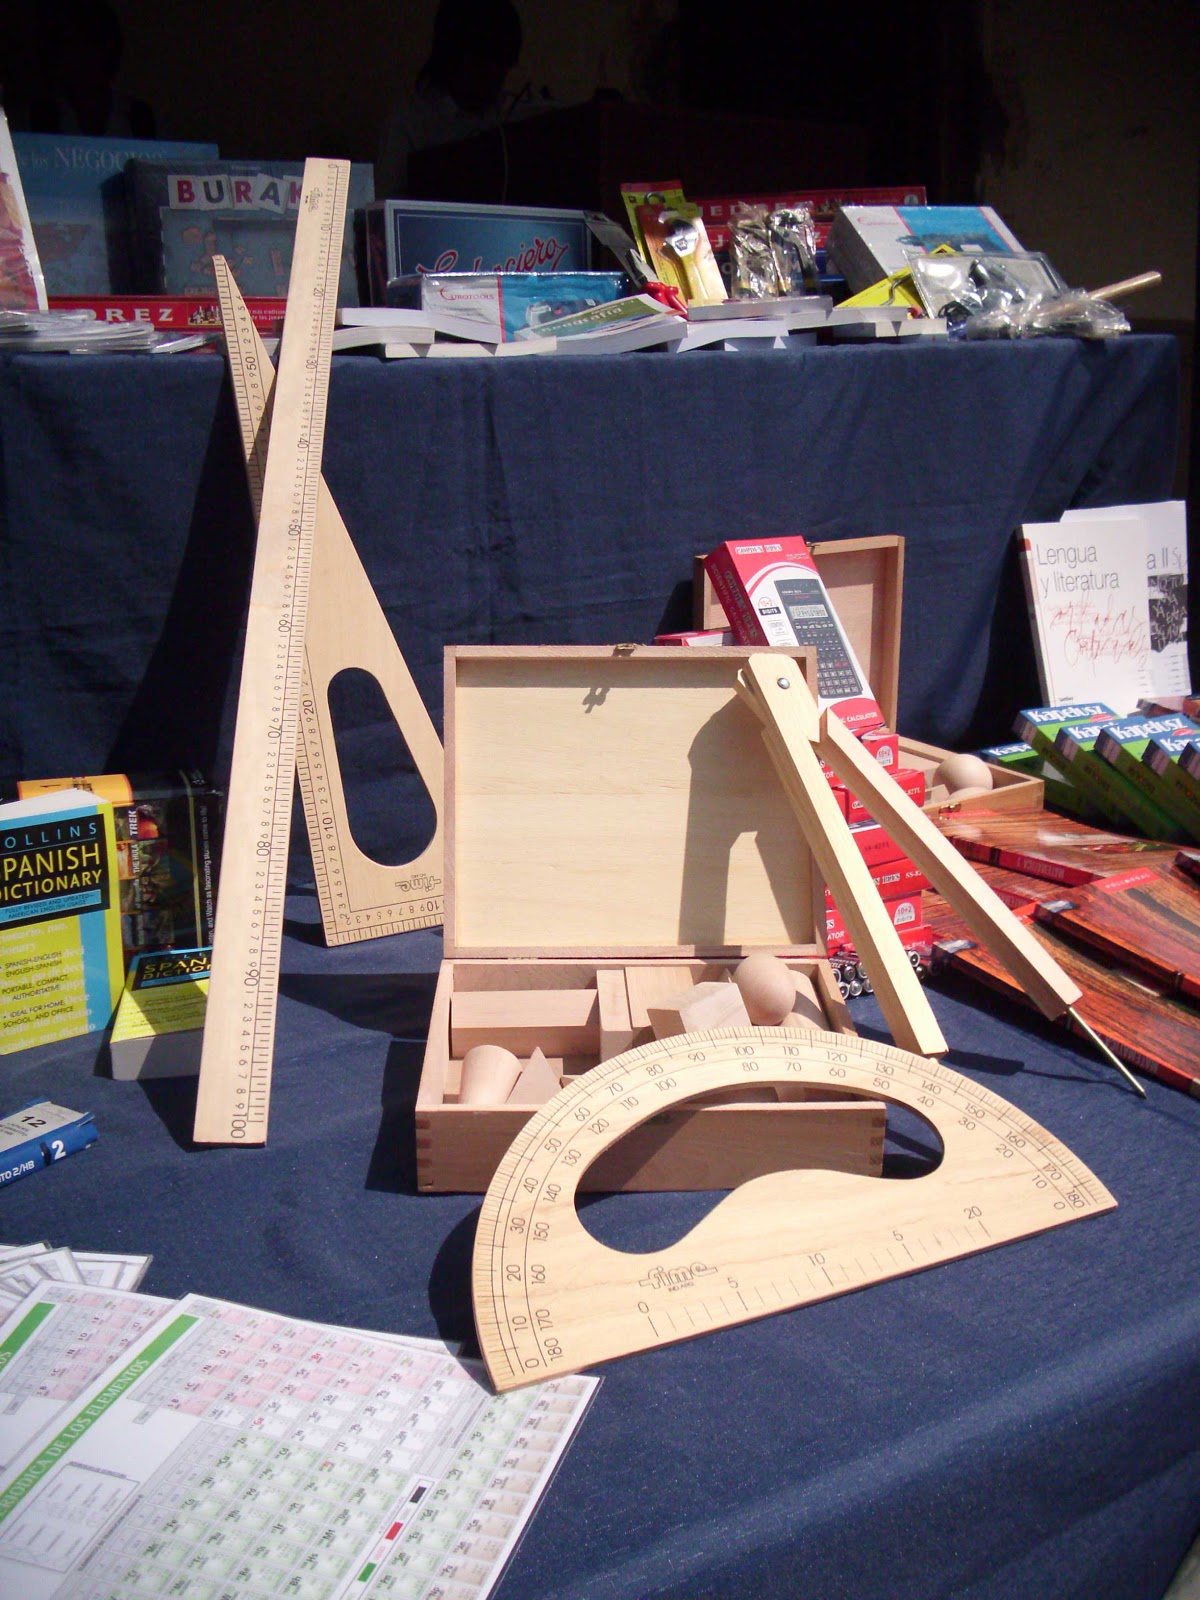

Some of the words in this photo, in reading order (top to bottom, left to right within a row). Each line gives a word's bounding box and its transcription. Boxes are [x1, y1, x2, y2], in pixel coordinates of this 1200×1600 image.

[177, 180, 302, 205] BURAK
[245, 356, 256, 371] 50
[288, 524, 301, 536] 50
[1036, 545, 1098, 569] Lengua
[1040, 577, 1050, 598] y
[1053, 571, 1120, 594] literatura
[278, 619, 291, 633] 60
[303, 700, 315, 715] 20
[847, 712, 877, 723] CALCULATOR
[267, 725, 282, 739] 70
[128, 810, 138, 836] TREK
[322, 817, 334, 832] 10
[4, 822, 97, 849] OLLINS
[256, 840, 271, 857] 80
[0, 843, 101, 883] PANISH
[897, 905, 912, 914] 10+2
[143, 964, 212, 980] DICTIO
[145, 957, 207, 974] SPAN
[244, 969, 260, 987] 90
[12, 984, 61, 1001] AUTHORITATIVE
[10, 1007, 28, 1018] IDEAL
[29, 1004, 42, 1013] FOR
[35, 1011, 49, 1020] AND
[51, 1005, 74, 1016] OFFICE
[688, 1051, 707, 1063] 90
[733, 1046, 755, 1057] 100
[782, 1045, 801, 1057] 110
[826, 1050, 848, 1063] 120
[645, 1063, 664, 1077] 80
[742, 1061, 760, 1072] 80
[785, 1062, 802, 1073] 70
[829, 1067, 847, 1079] 60
[875, 1062, 895, 1076] 130
[606, 1082, 624, 1096] 70
[655, 1077, 677, 1092] 100
[872, 1077, 891, 1091] 50
[920, 1080, 942, 1096] 140
[619, 1096, 640, 1112] 110
[916, 1094, 935, 1109] 40
[574, 1106, 592, 1123] 60
[963, 1102, 986, 1120] 150
[230, 1113, 248, 1139] 100
[587, 1118, 610, 1137] 120
[958, 1116, 977, 1131] 30
[544, 1137, 562, 1154] 50
[1004, 1130, 1027, 1149] 160
[51, 1140, 67, 1160] 2
[561, 1149, 582, 1167] 130
[995, 1143, 1015, 1159] 20
[12, 1160, 35, 1177] 2/HB
[1041, 1162, 1063, 1181] 170
[523, 1177, 540, 1194] 40
[1031, 1174, 1048, 1190] 10
[543, 1184, 562, 1205] 140
[1065, 1189, 1085, 1209] 180
[963, 1206, 983, 1220] 20
[1053, 1201, 1066, 1211] 0
[510, 1217, 526, 1235] 30
[532, 1221, 550, 1243] 150
[892, 1229, 904, 1242] 5
[807, 1252, 826, 1267] 10
[506, 1265, 522, 1282] 20
[531, 1263, 546, 1285] 160
[727, 1277, 739, 1289] 5
[637, 1301, 650, 1314] 0
[513, 1315, 527, 1332] 10
[536, 1308, 553, 1332] 170
[547, 1337, 564, 1362] 180
[525, 1357, 540, 1369] 0
[45, 1439, 67, 1457] DE
[63, 1417, 92, 1439] LOS
[86, 1359, 149, 1416] ELEMENTOS
